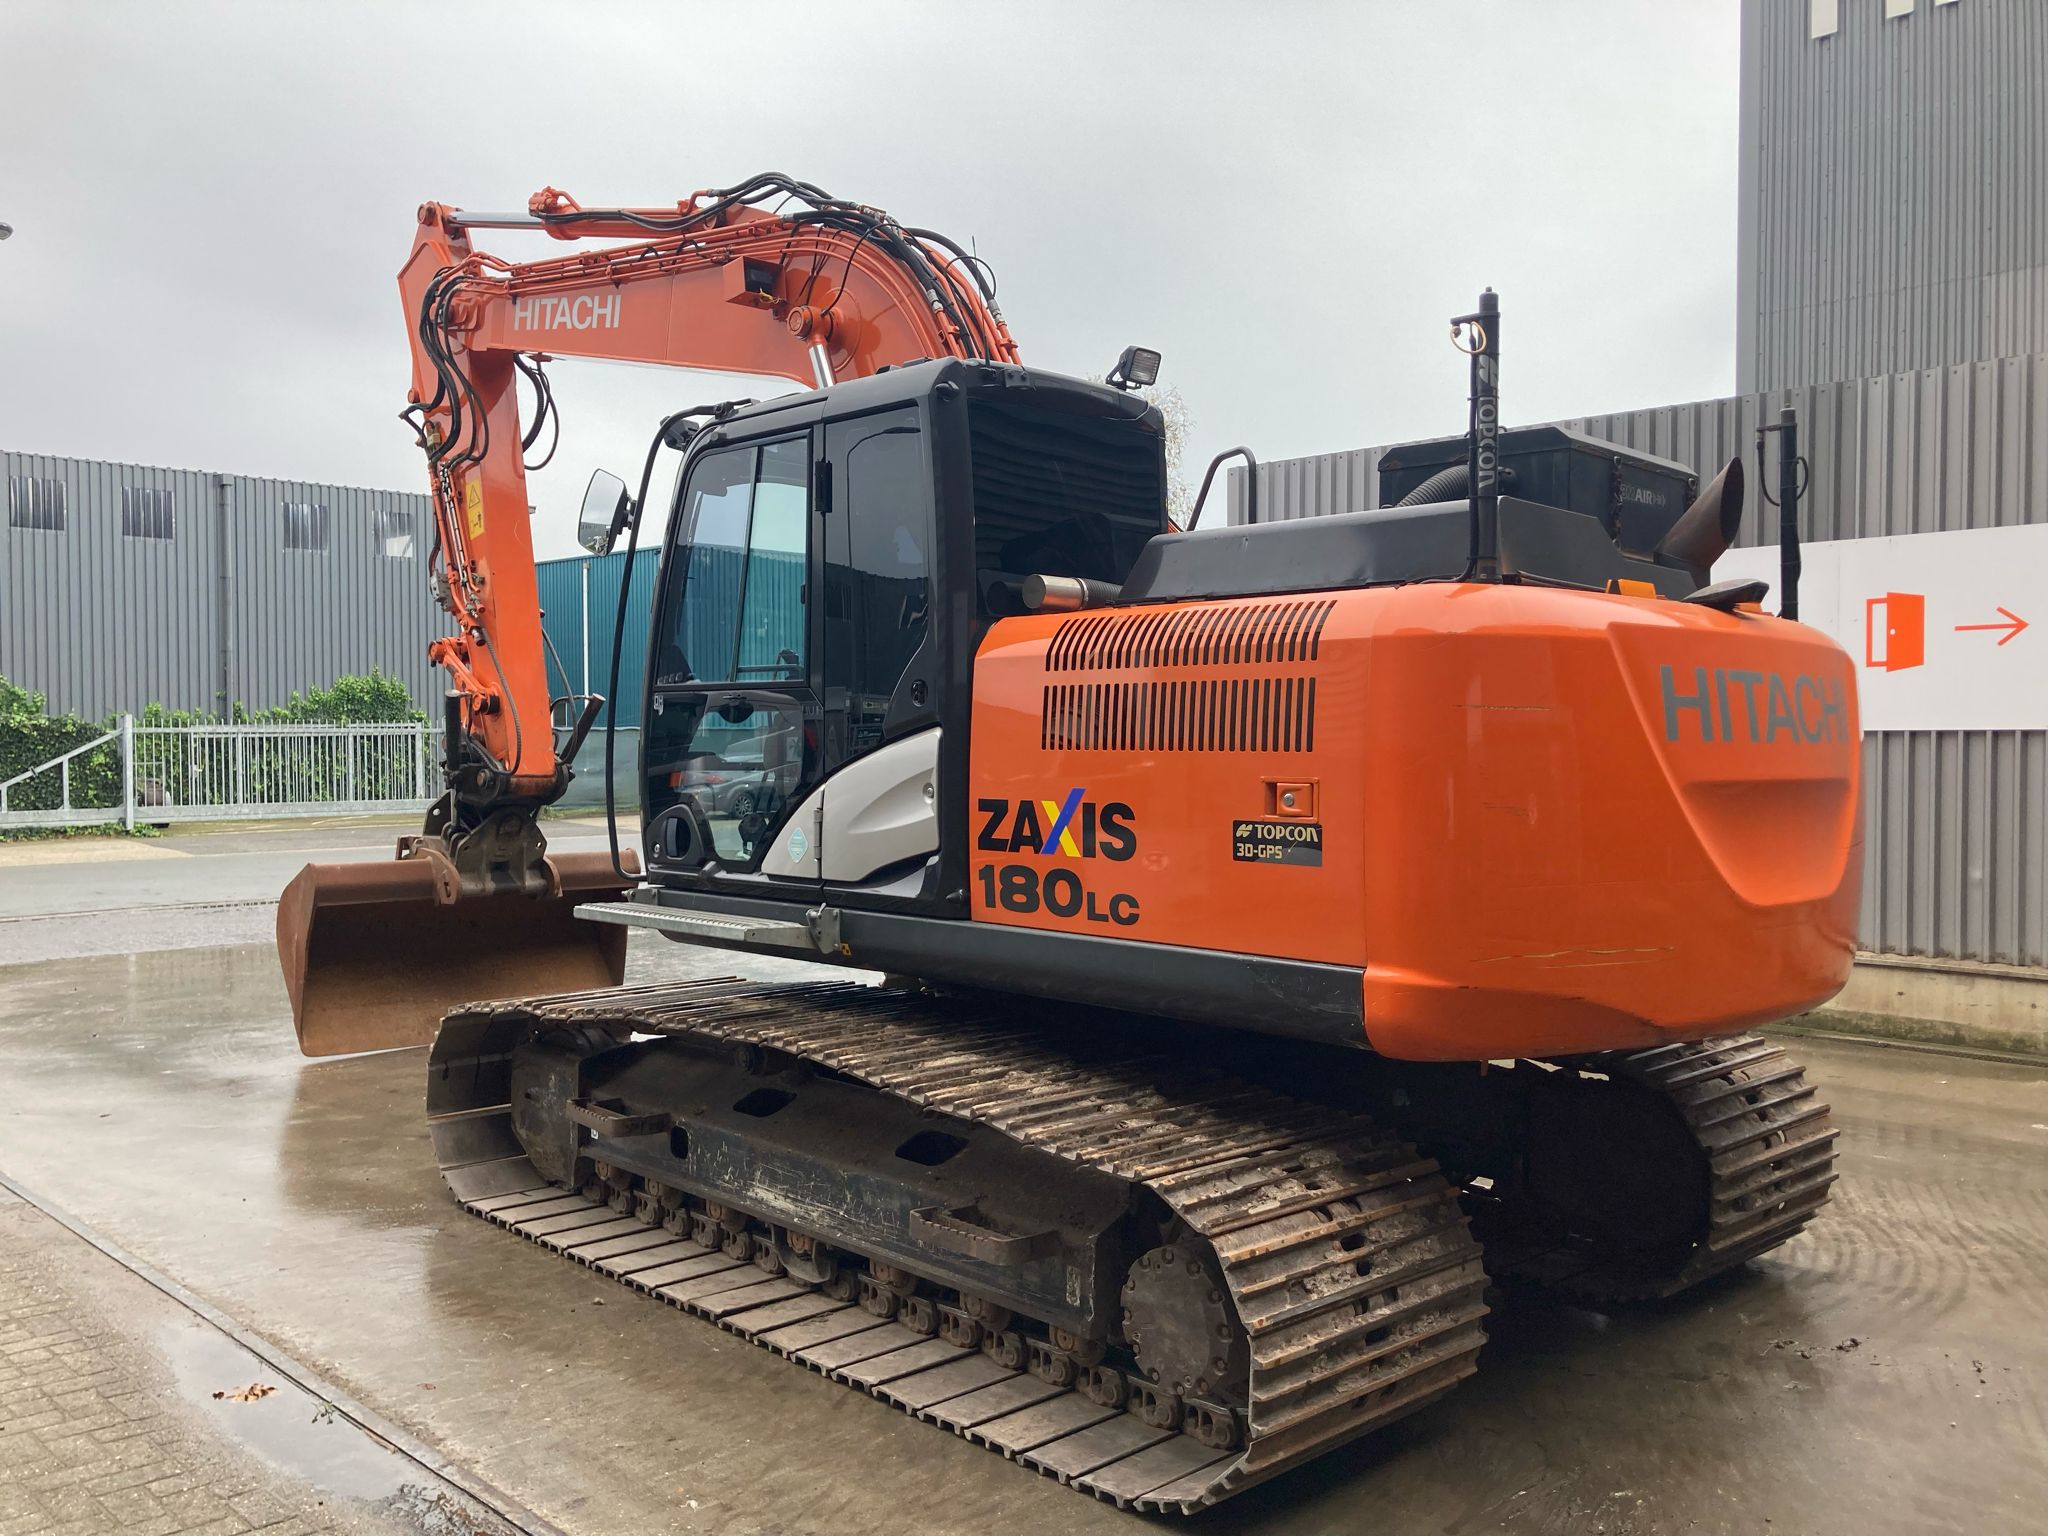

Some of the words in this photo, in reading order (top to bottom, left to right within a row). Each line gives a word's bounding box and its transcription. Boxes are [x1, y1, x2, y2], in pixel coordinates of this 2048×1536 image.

[513, 294, 622, 331] HITACHI
[1479, 389, 1496, 488] TOPCON
[977, 788, 1137, 861] ZAXIS
[1255, 824, 1318, 842] TOPCON
[1237, 842, 1282, 859] 3D-GPS
